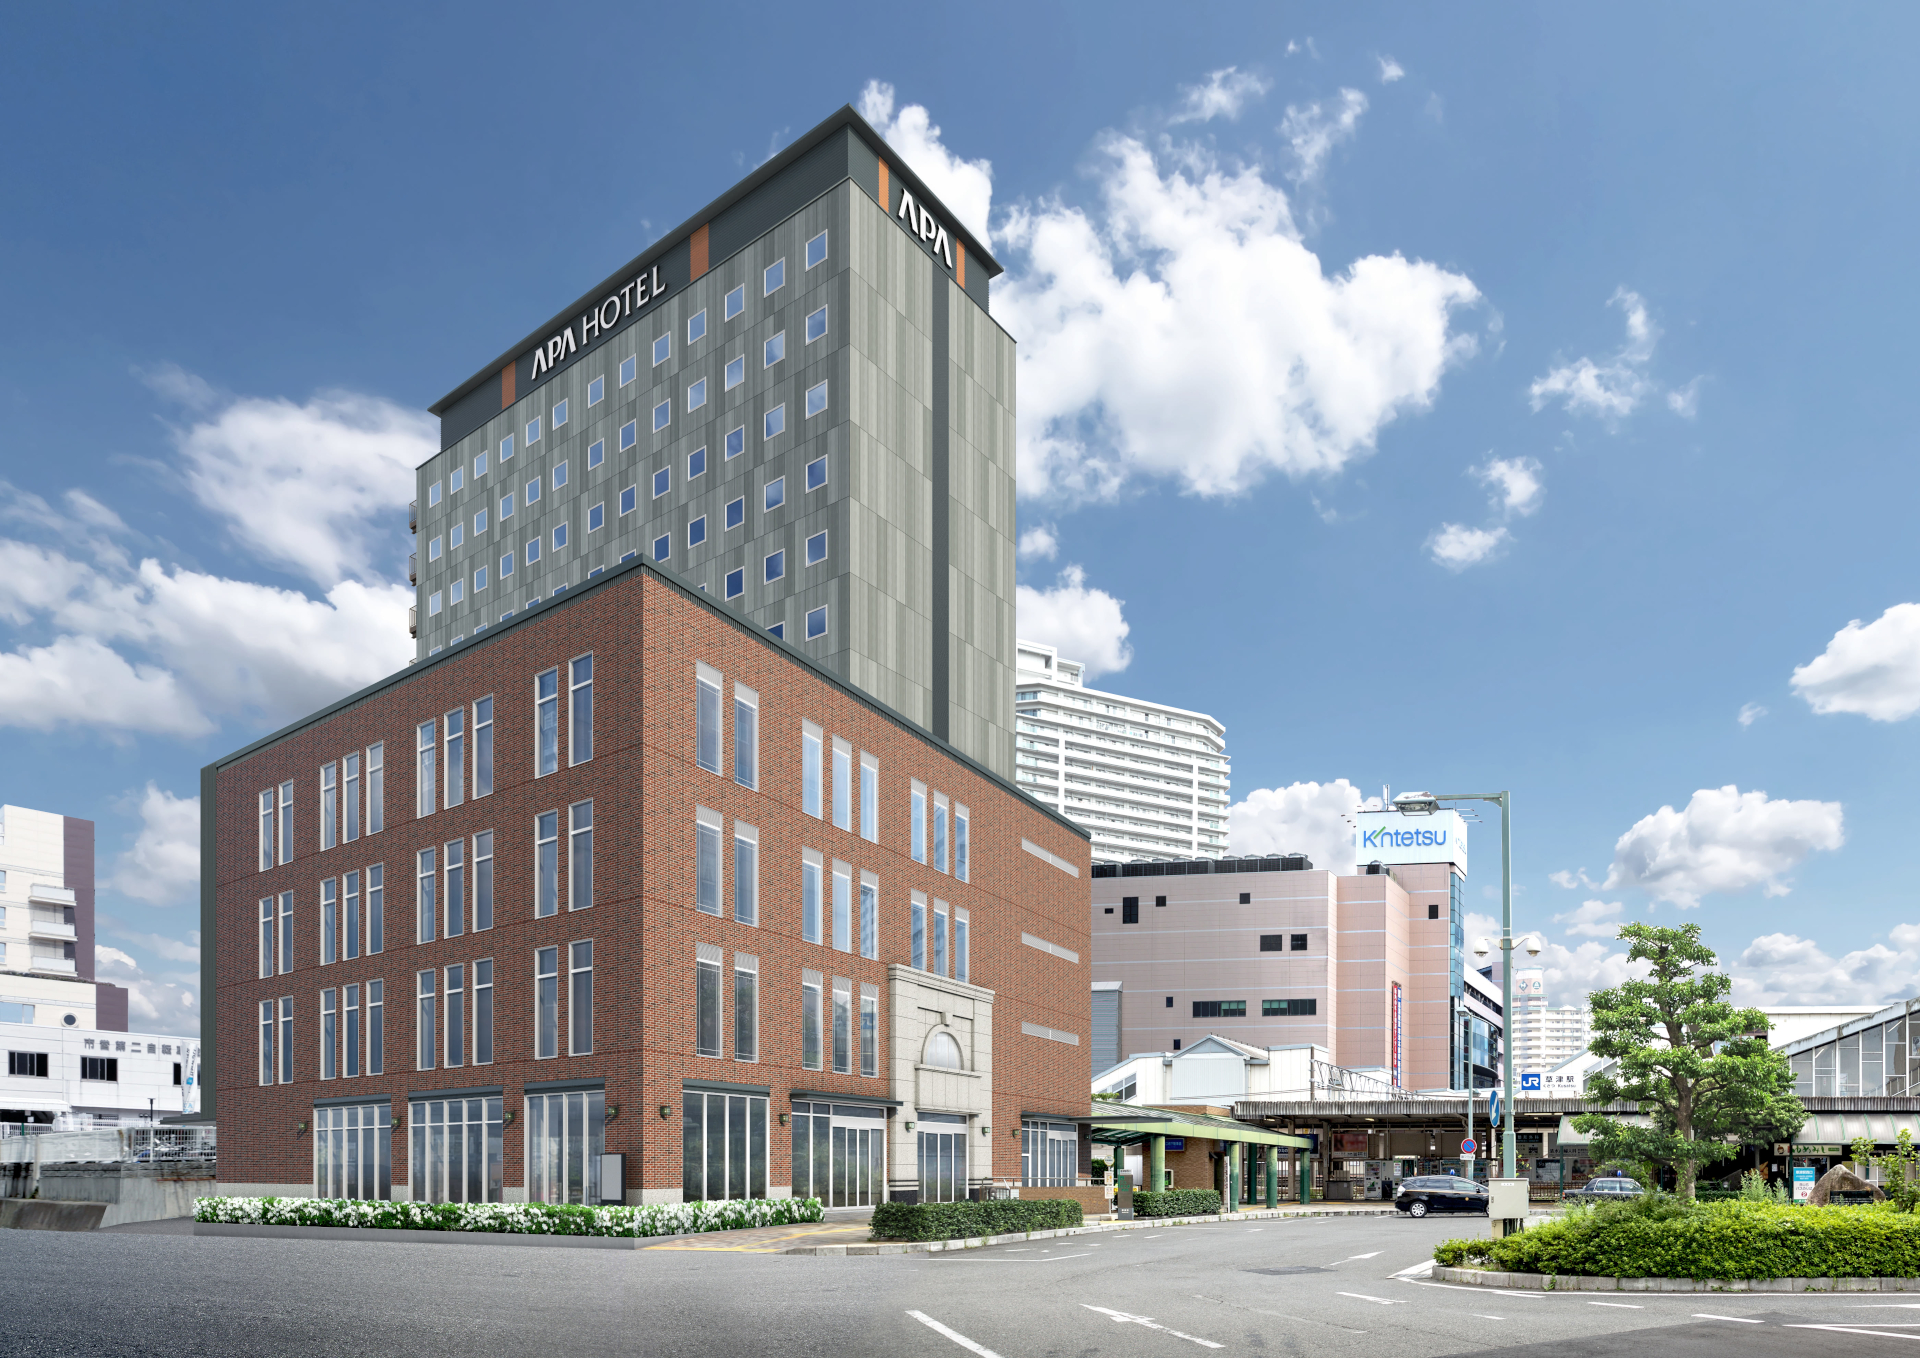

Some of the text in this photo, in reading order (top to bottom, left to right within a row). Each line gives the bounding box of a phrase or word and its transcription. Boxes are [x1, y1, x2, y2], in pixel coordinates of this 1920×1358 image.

[898, 187, 953, 269] APA
[531, 265, 666, 380] APA HOTEL
[1363, 826, 1447, 848] Kintetsu
[1523, 1077, 1539, 1087] JR
